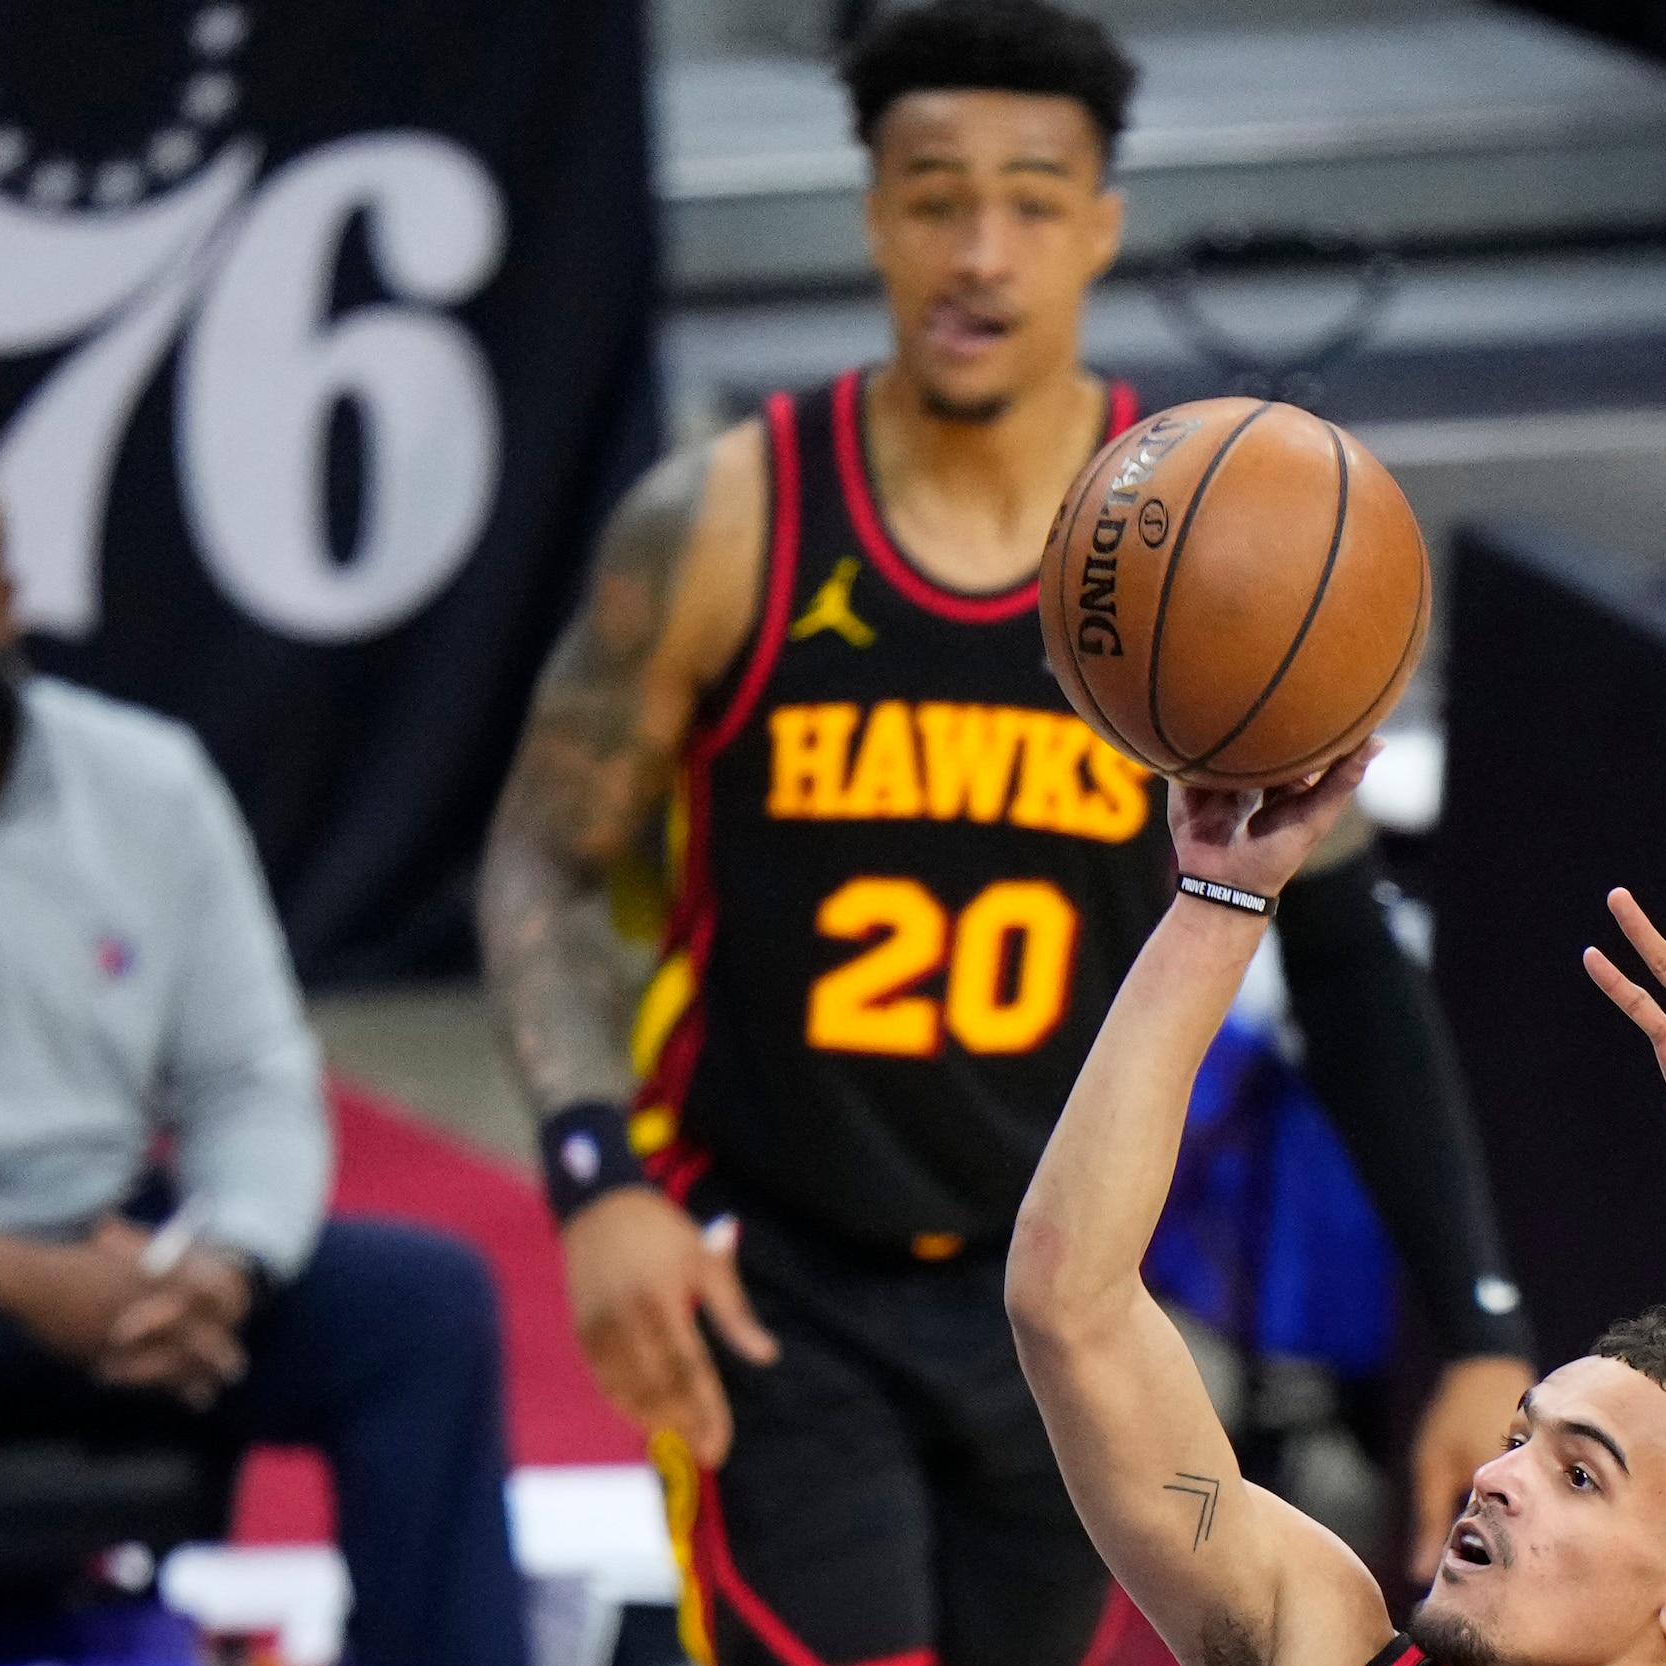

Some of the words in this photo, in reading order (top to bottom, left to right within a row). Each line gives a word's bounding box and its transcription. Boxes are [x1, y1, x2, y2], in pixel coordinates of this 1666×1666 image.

[765, 698, 1155, 845] HAWKS
[1180, 876, 1208, 896] PROVE
[1206, 882, 1232, 902] THEM
[1231, 889, 1267, 912] WRONG
[805, 874, 1080, 1062] 20
